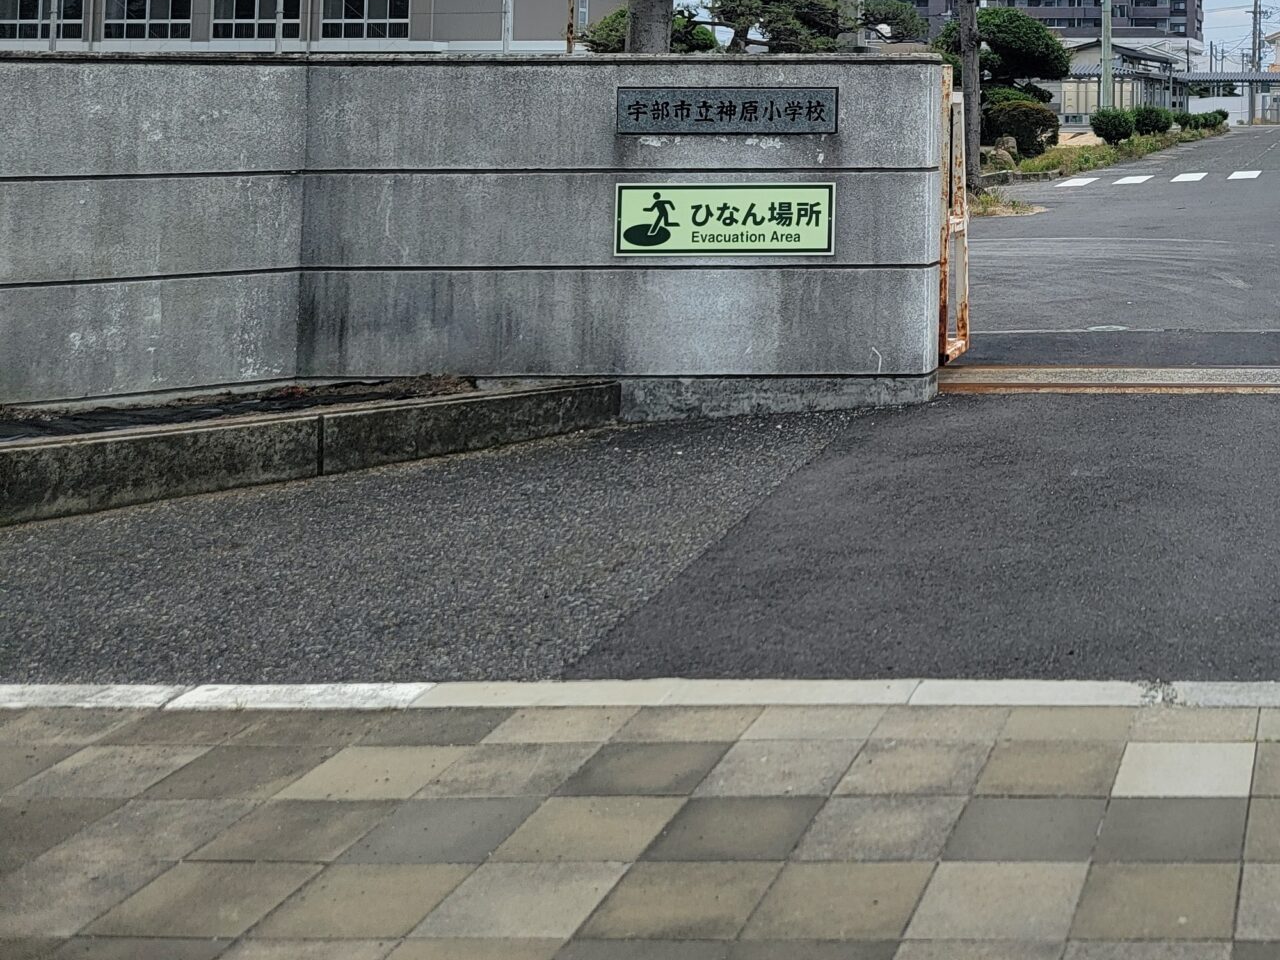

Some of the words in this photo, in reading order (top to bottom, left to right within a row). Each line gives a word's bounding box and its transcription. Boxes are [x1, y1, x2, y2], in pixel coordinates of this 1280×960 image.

[627, 100, 827, 123] 宇部市立神原小学校
[690, 202, 822, 227] ひなん場所
[691, 231, 766, 243] Evacuation
[770, 231, 801, 243] Area
